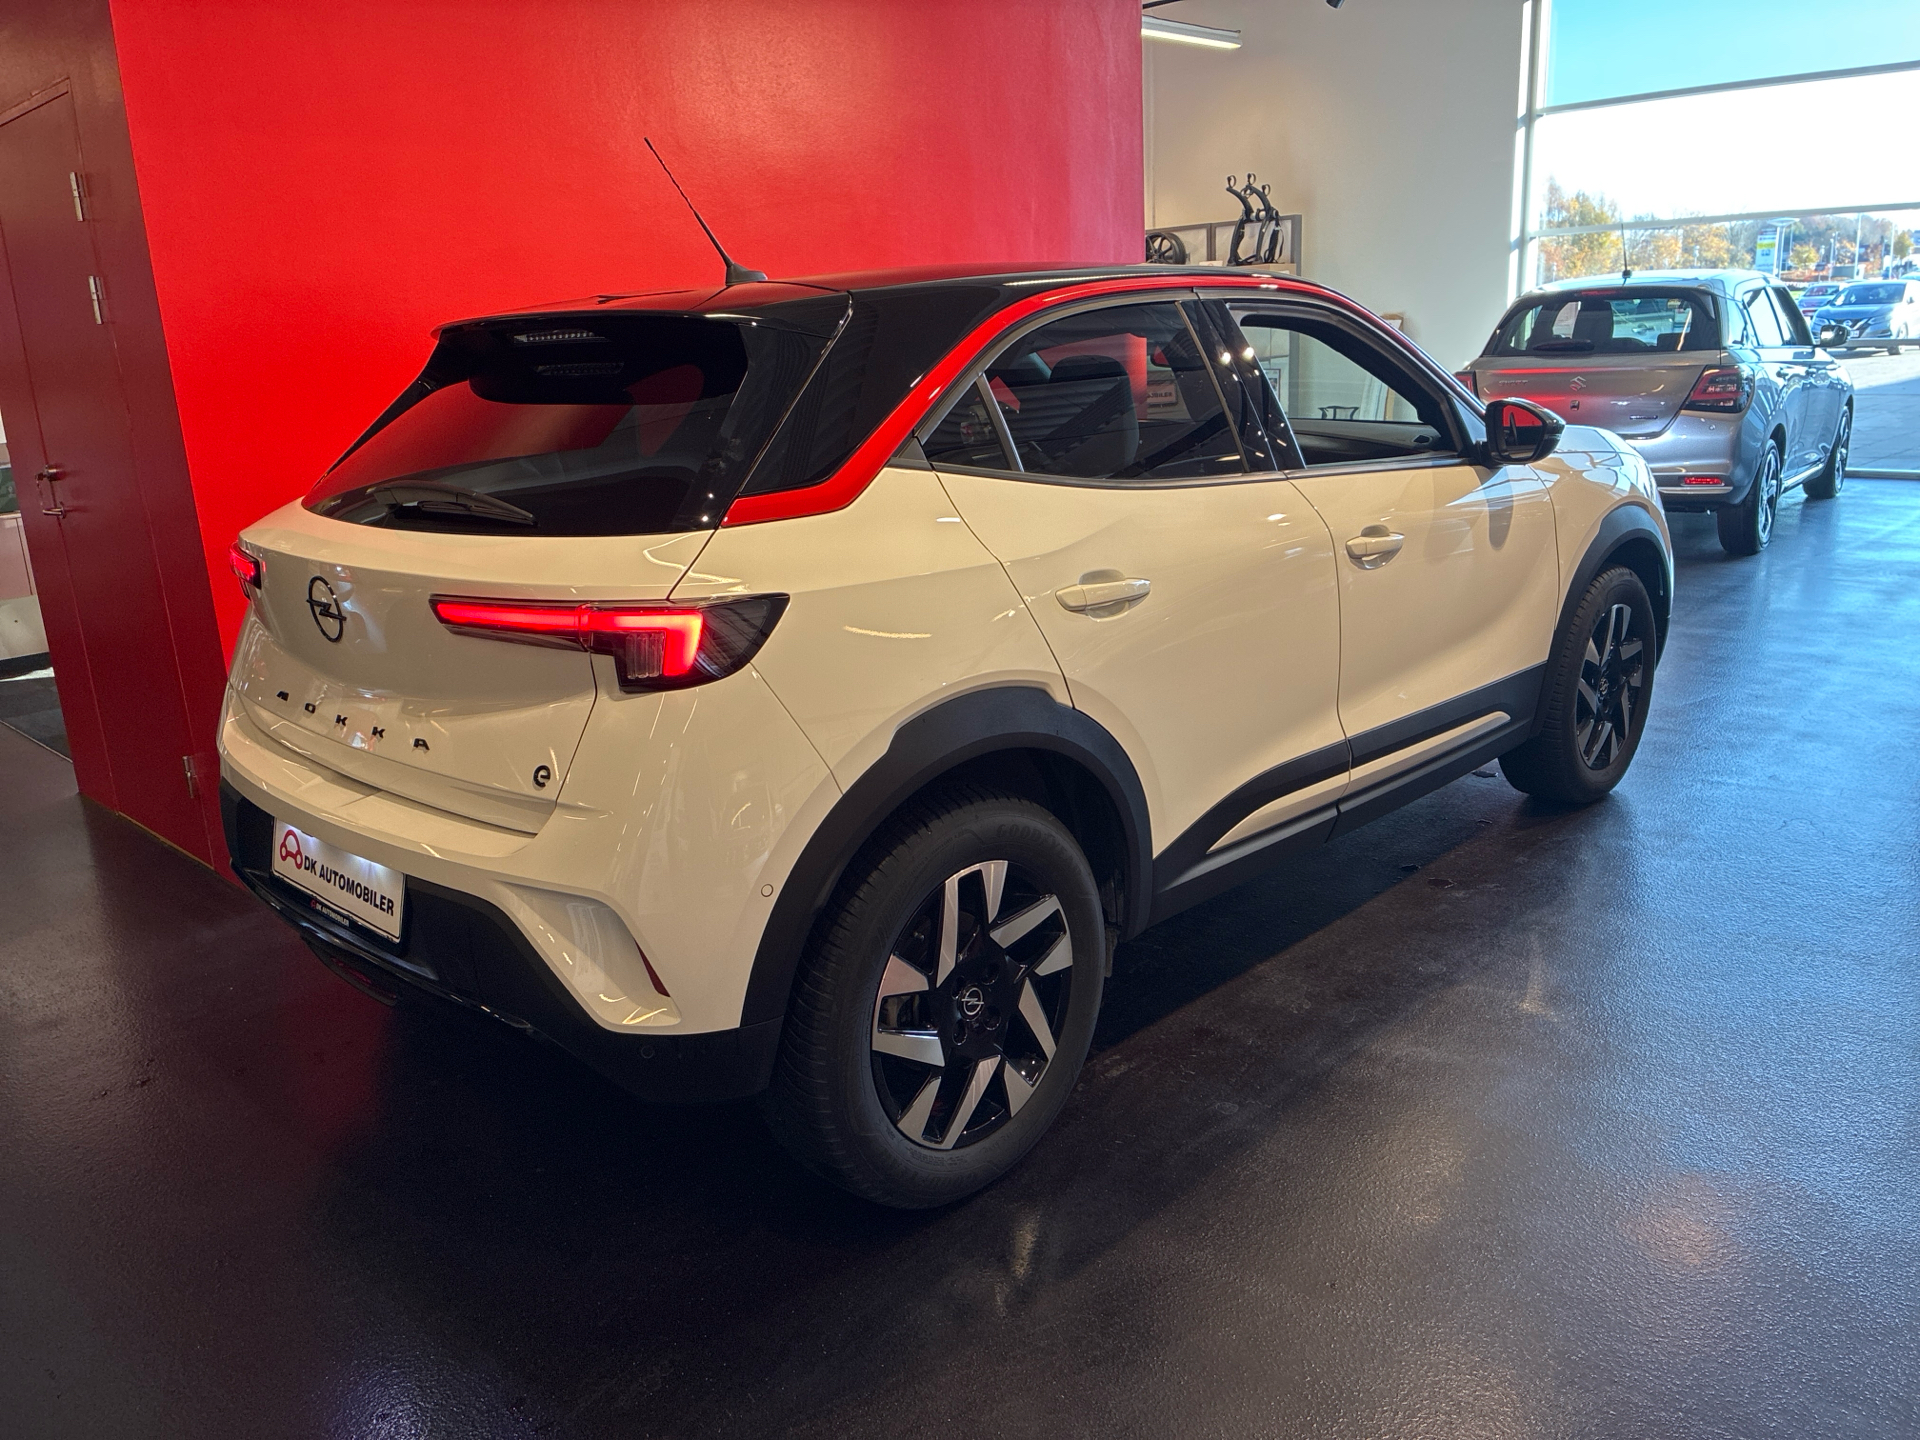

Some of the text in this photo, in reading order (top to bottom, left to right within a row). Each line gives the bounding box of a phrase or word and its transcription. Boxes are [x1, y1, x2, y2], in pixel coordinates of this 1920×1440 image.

[276, 690, 430, 751] MOKKA
[533, 765, 550, 788] e
[304, 855, 394, 916] DK AUTOMOBILER
